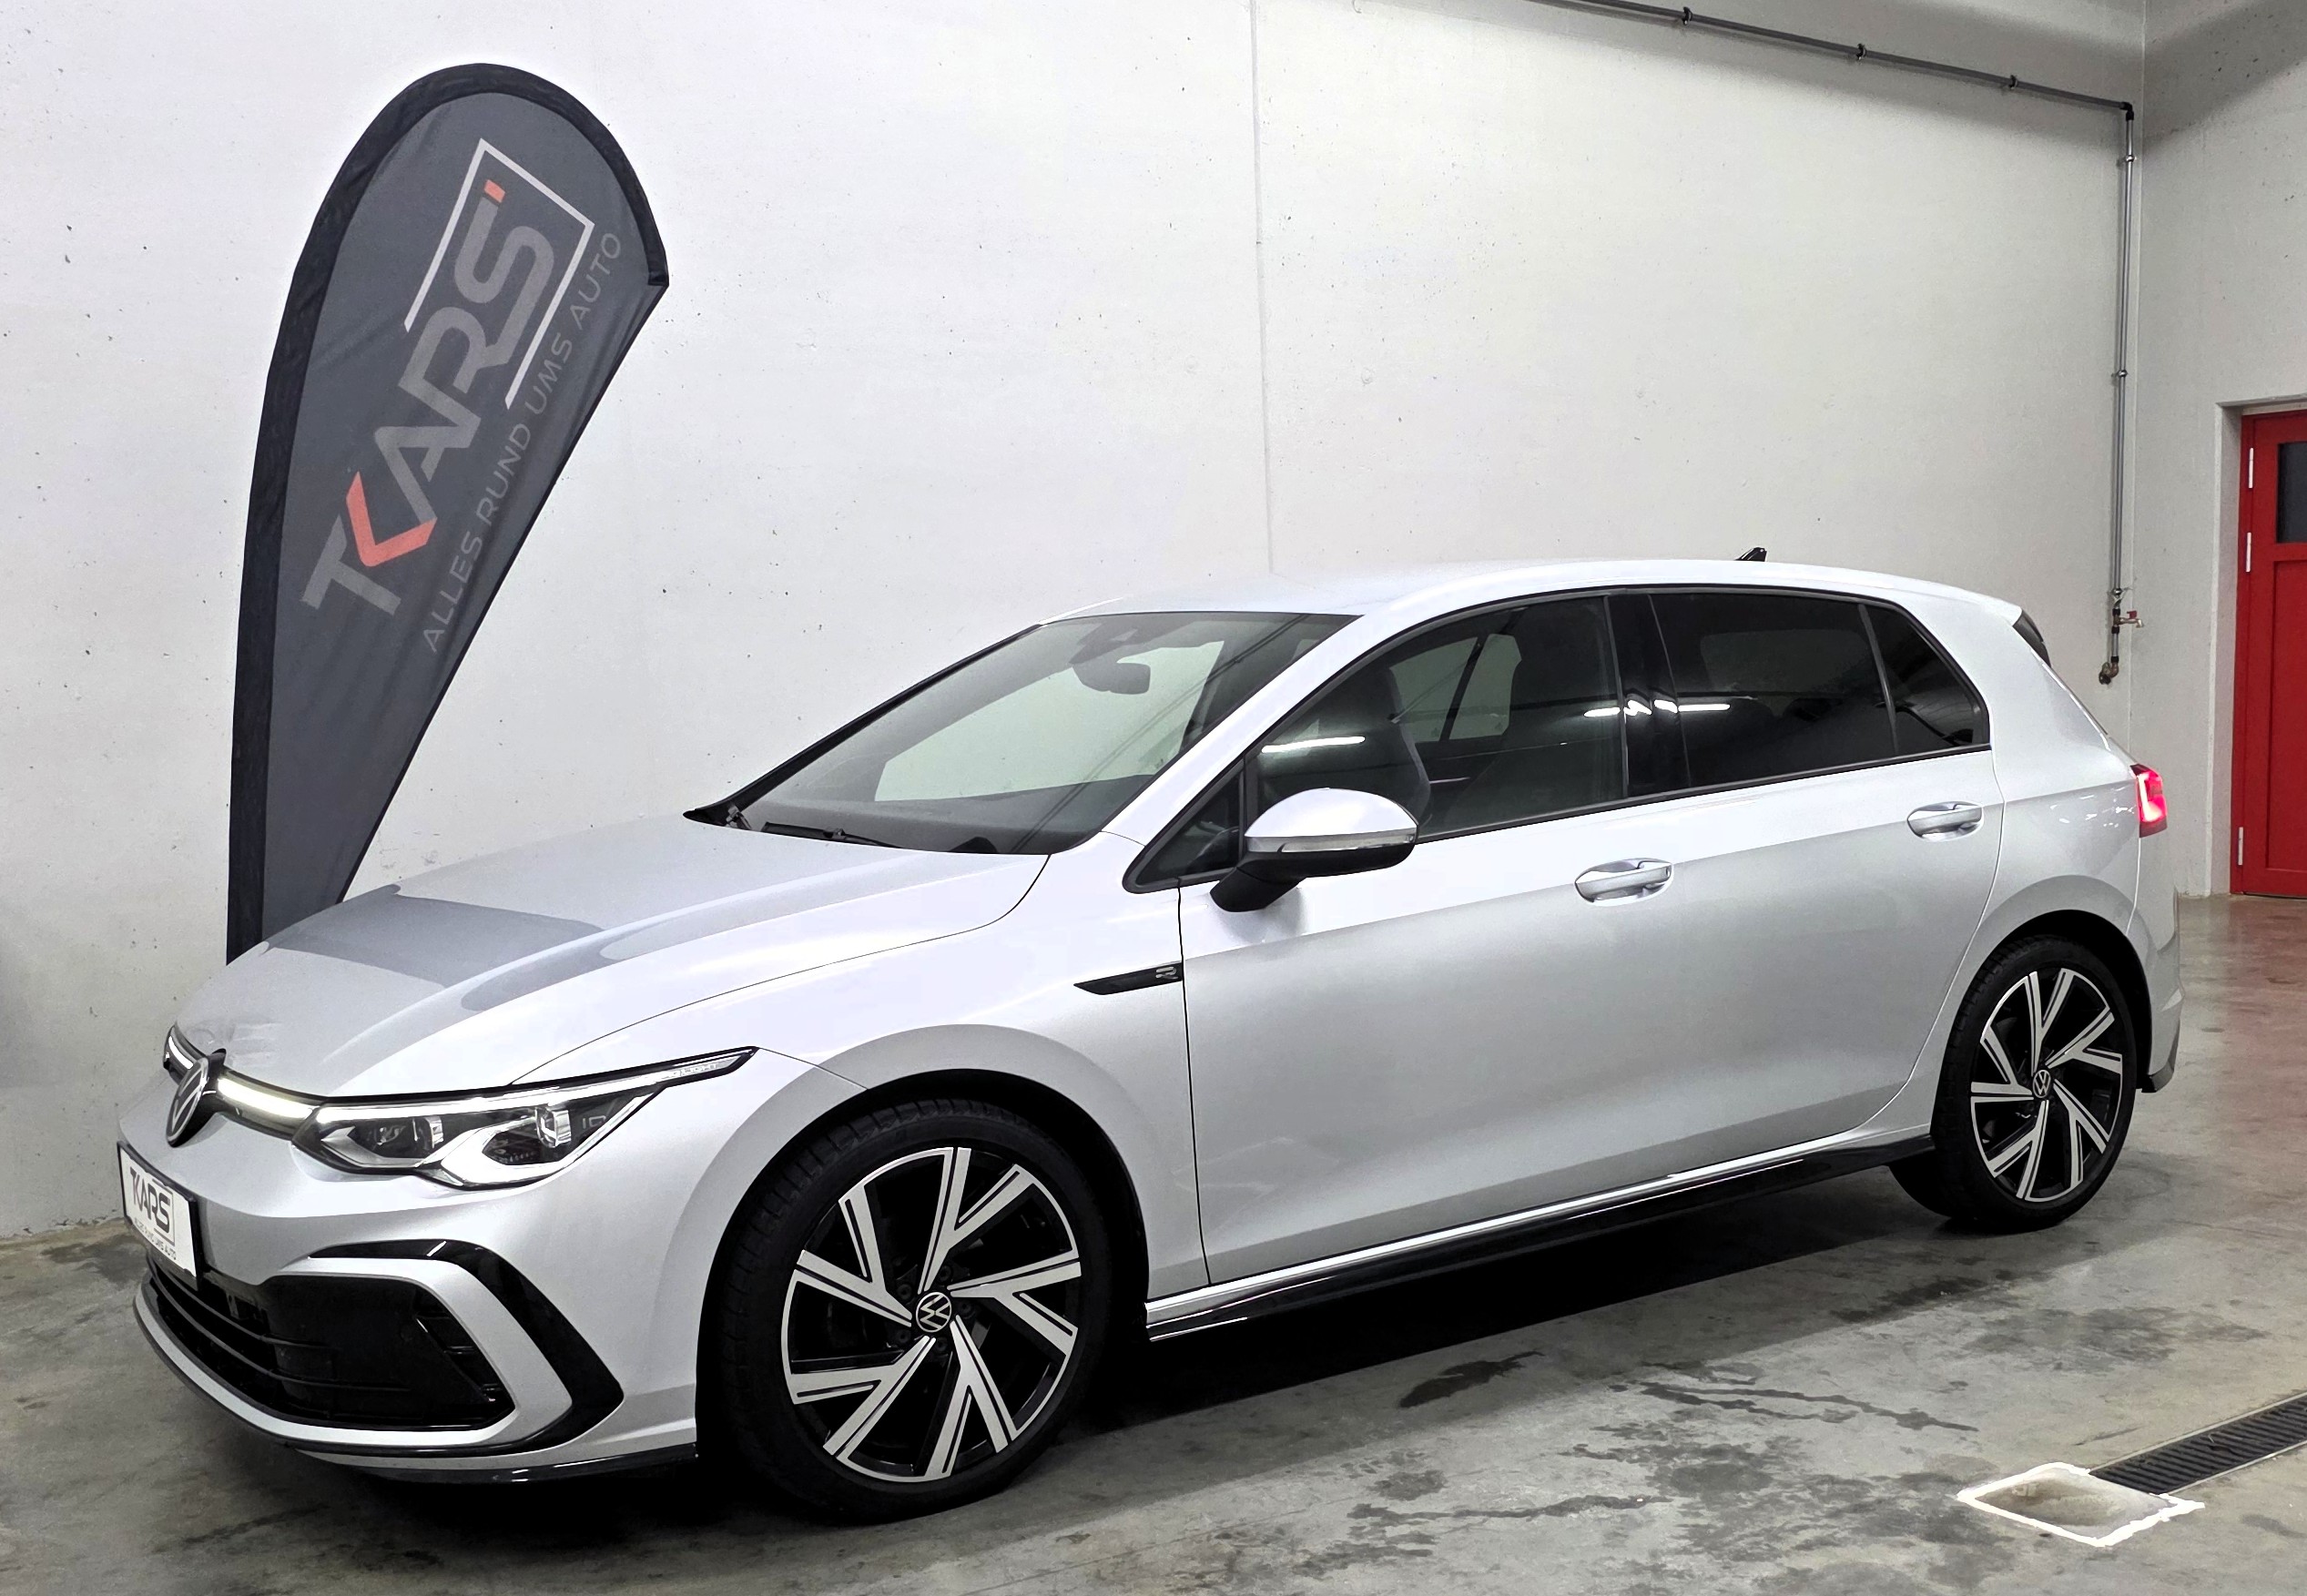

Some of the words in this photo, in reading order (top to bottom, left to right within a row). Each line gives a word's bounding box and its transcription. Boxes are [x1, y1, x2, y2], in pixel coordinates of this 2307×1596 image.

[423, 531, 483, 653] ALLES
[475, 423, 532, 526] RUND
[524, 332, 573, 414] UMS
[570, 232, 621, 330] AUTO
